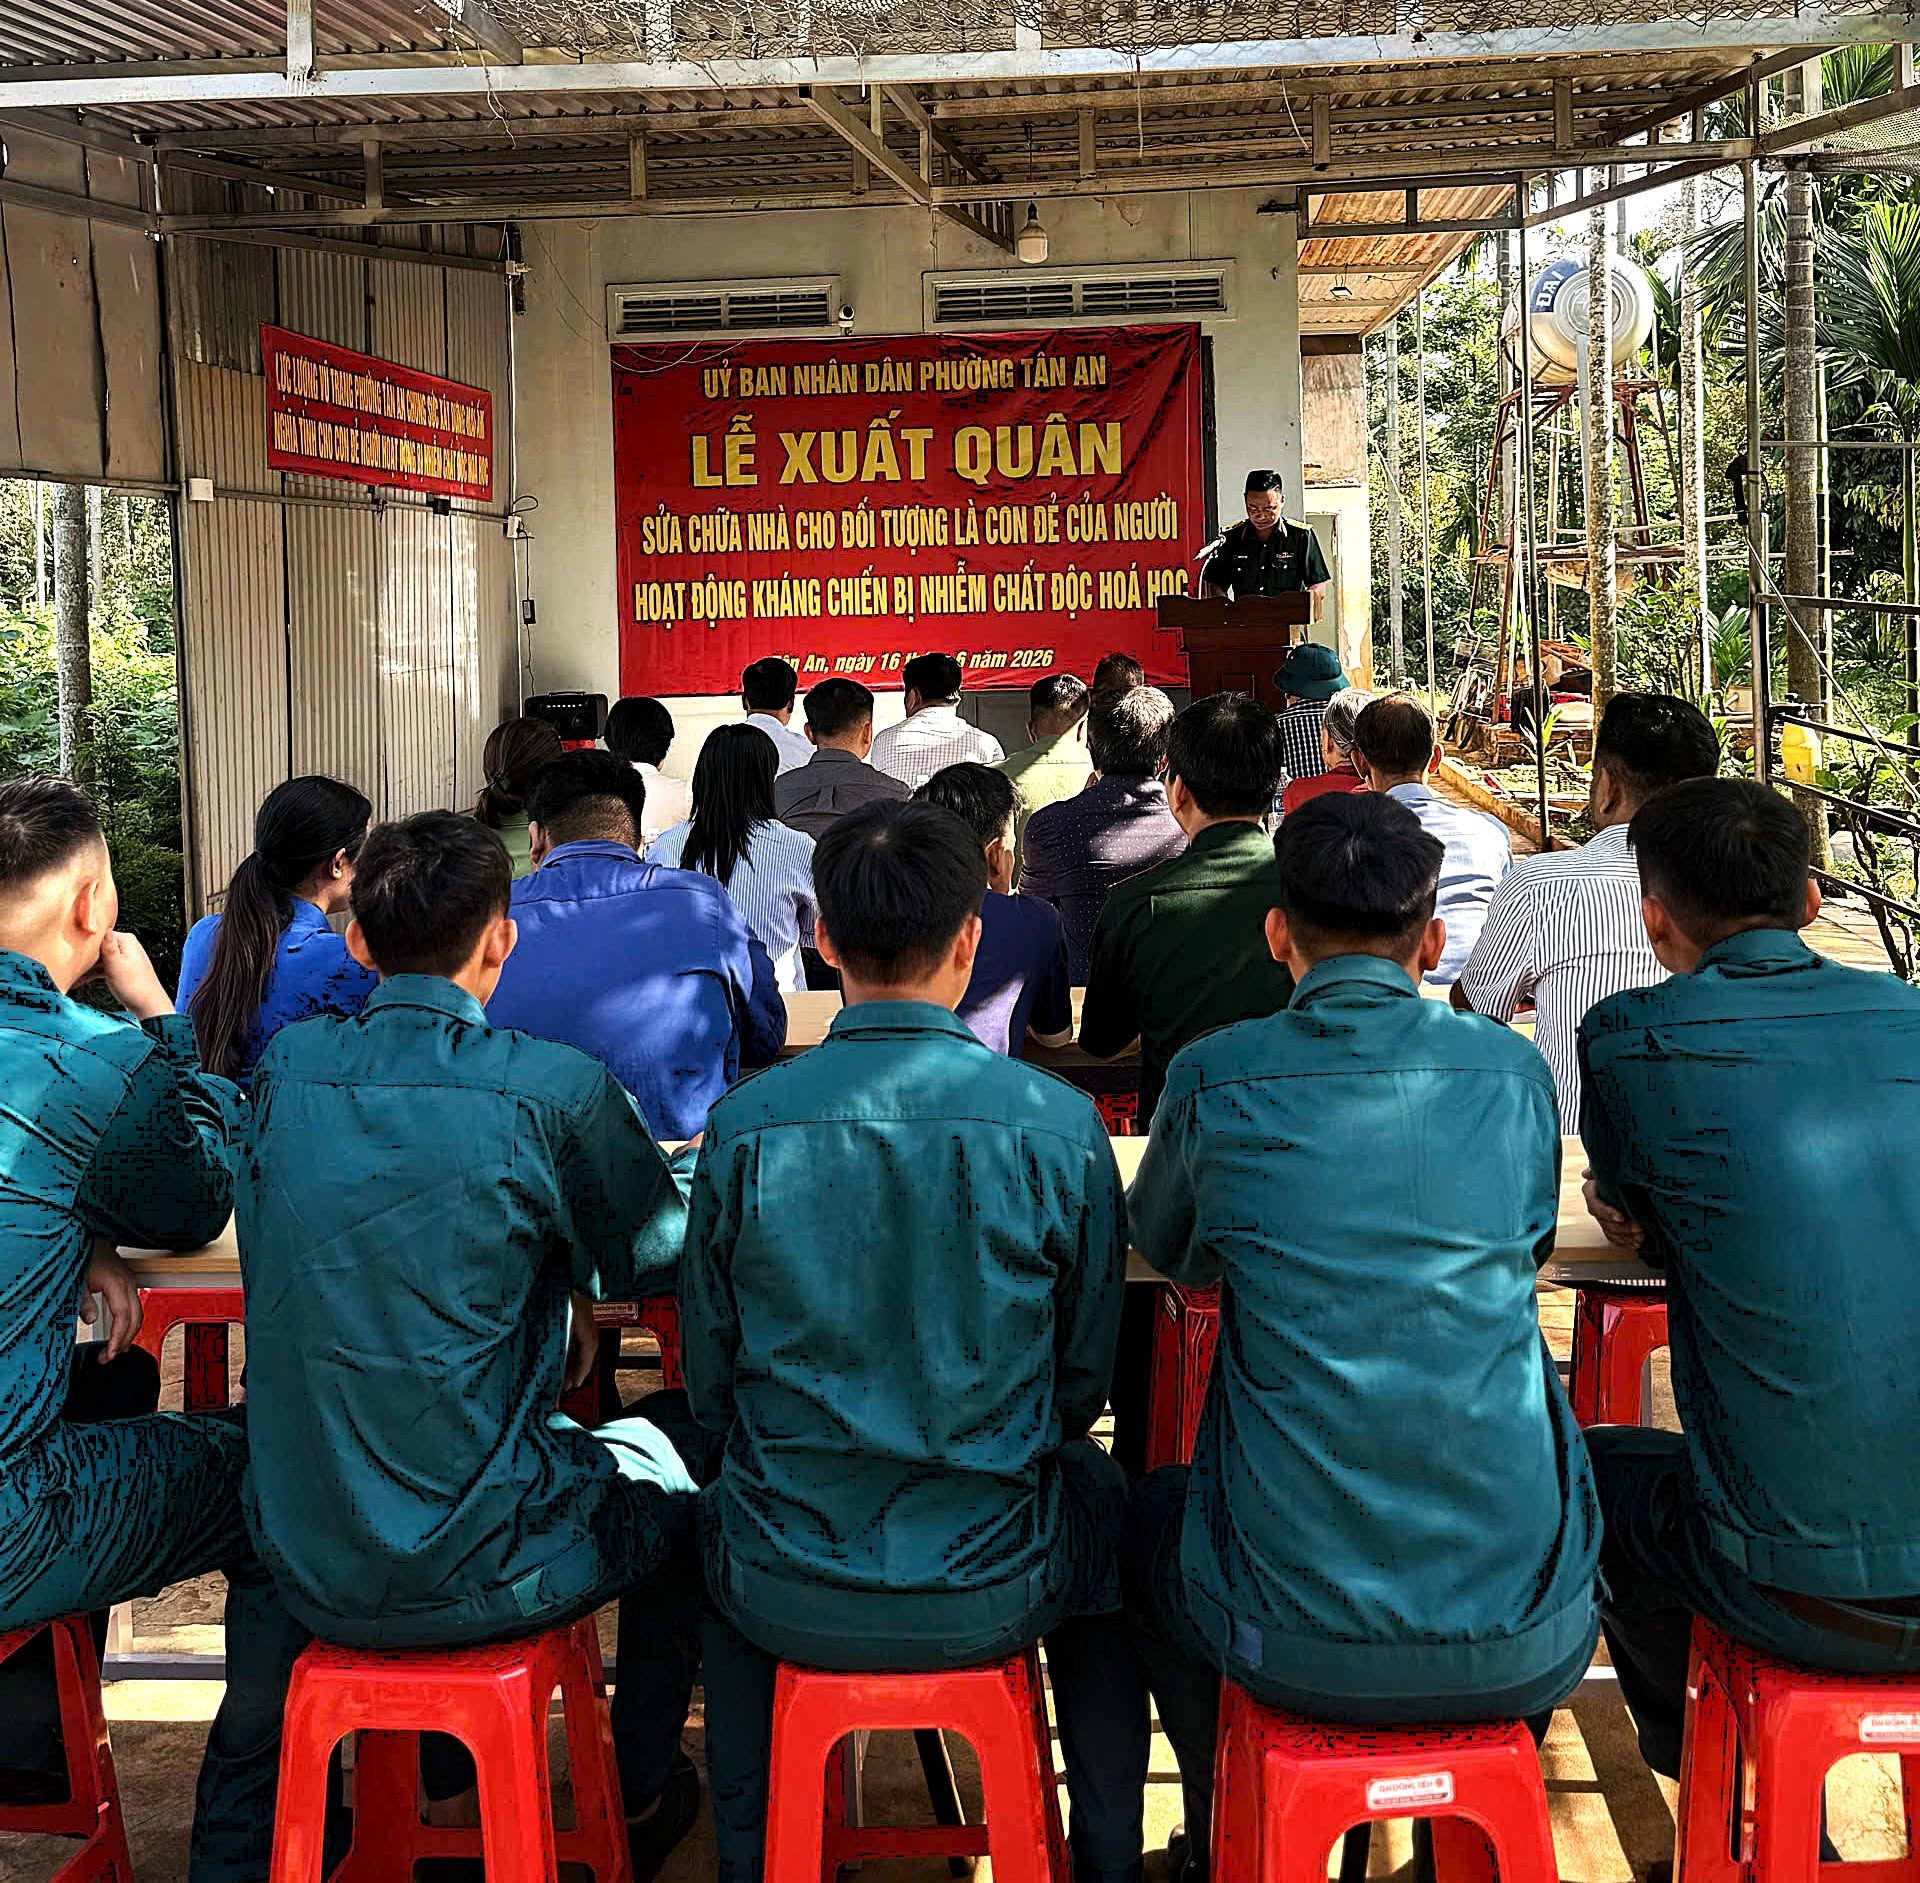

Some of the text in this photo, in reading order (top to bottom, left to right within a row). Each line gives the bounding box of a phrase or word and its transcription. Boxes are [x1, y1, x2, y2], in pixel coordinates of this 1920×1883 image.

[704, 352, 1106, 398] UỶ BAN NHÂN DÂN PHƯỜNG TÂN AN
[692, 410, 1121, 486] LỄ XUẤT QUÂN
[642, 491, 1178, 555] SỬA CHỮA NHÀ CHO ĐỐI TƯỢNG LÀ CON ĐẺ CỦA NGƯỜI
[635, 582, 685, 629] HOẠT
[692, 573, 746, 627] ĐỘNG
[753, 571, 821, 617] KHÁNG
[827, 564, 888, 616] CHIẾN
[893, 576, 914, 623] BỊ
[920, 560, 987, 614] NHIỄM
[993, 560, 1046, 612] CHẤT
[1051, 563, 1092, 619] ĐỘC
[1099, 562, 1142, 610] HOÁ
[803, 654, 829, 675] An,
[834, 654, 876, 674] ngày
[880, 652, 901, 671] 16
[969, 650, 1008, 669] năm
[1009, 650, 1054, 669] 2026
